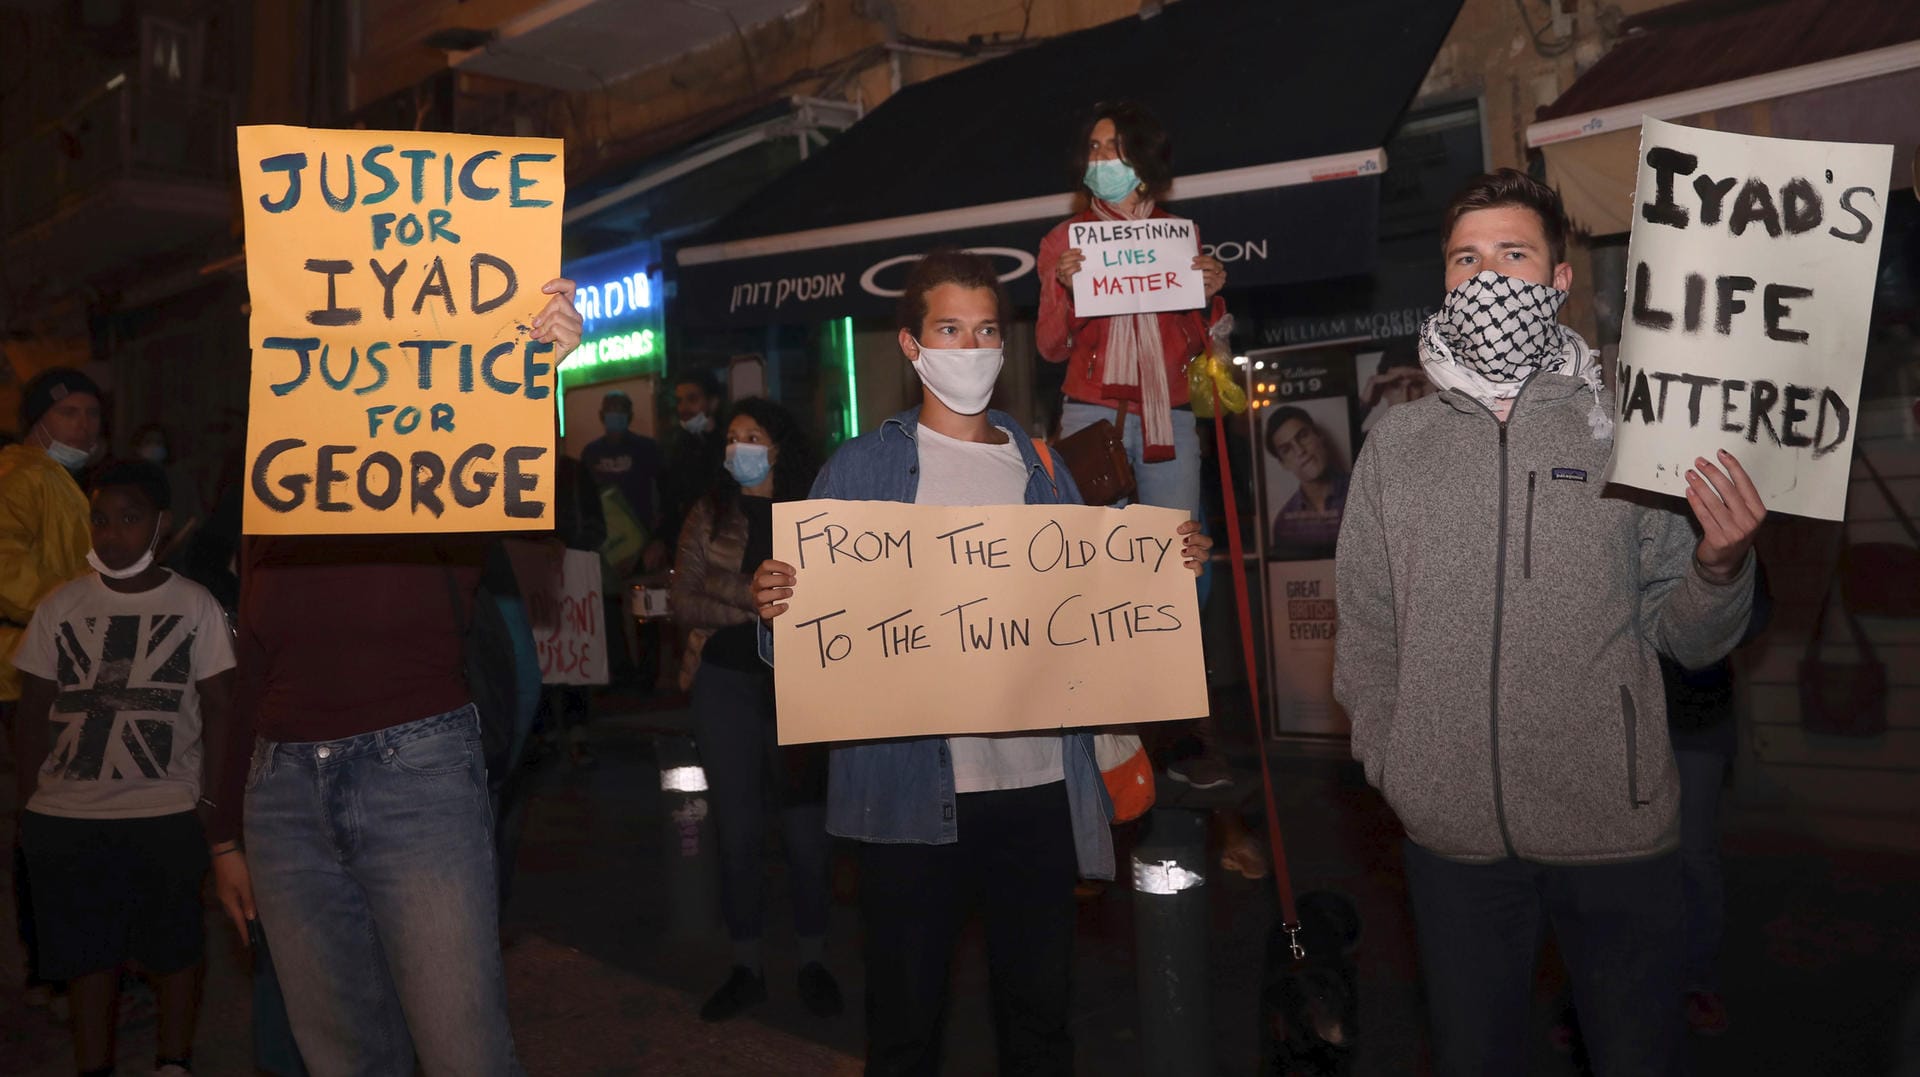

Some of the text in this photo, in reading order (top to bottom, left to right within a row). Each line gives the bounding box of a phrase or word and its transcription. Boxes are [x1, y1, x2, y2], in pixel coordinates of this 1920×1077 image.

[259, 144, 558, 213] JUSTICE
[1642, 146, 1880, 244] IYAD'S
[371, 208, 460, 251] FOR
[1103, 248, 1157, 268] LIVES
[304, 252, 519, 326] IYAD
[730, 271, 846, 314] אופטיק דורון
[1092, 271, 1183, 296] MATTER
[1632, 261, 1814, 344] LIFE
[1264, 319, 1346, 344] WILLIAM
[1371, 322, 1416, 339] LOND
[262, 337, 555, 400] JUSTICE
[1272, 378, 1322, 396] 019
[366, 403, 456, 438] FOR
[251, 438, 548, 519] GEORGE
[795, 512, 1173, 573] FROM THE OLD CITY
[1286, 580, 1321, 598] GREAT
[795, 594, 1182, 668] TO THE TWIN CITIES
[1289, 622, 1337, 640] EYEWEA
